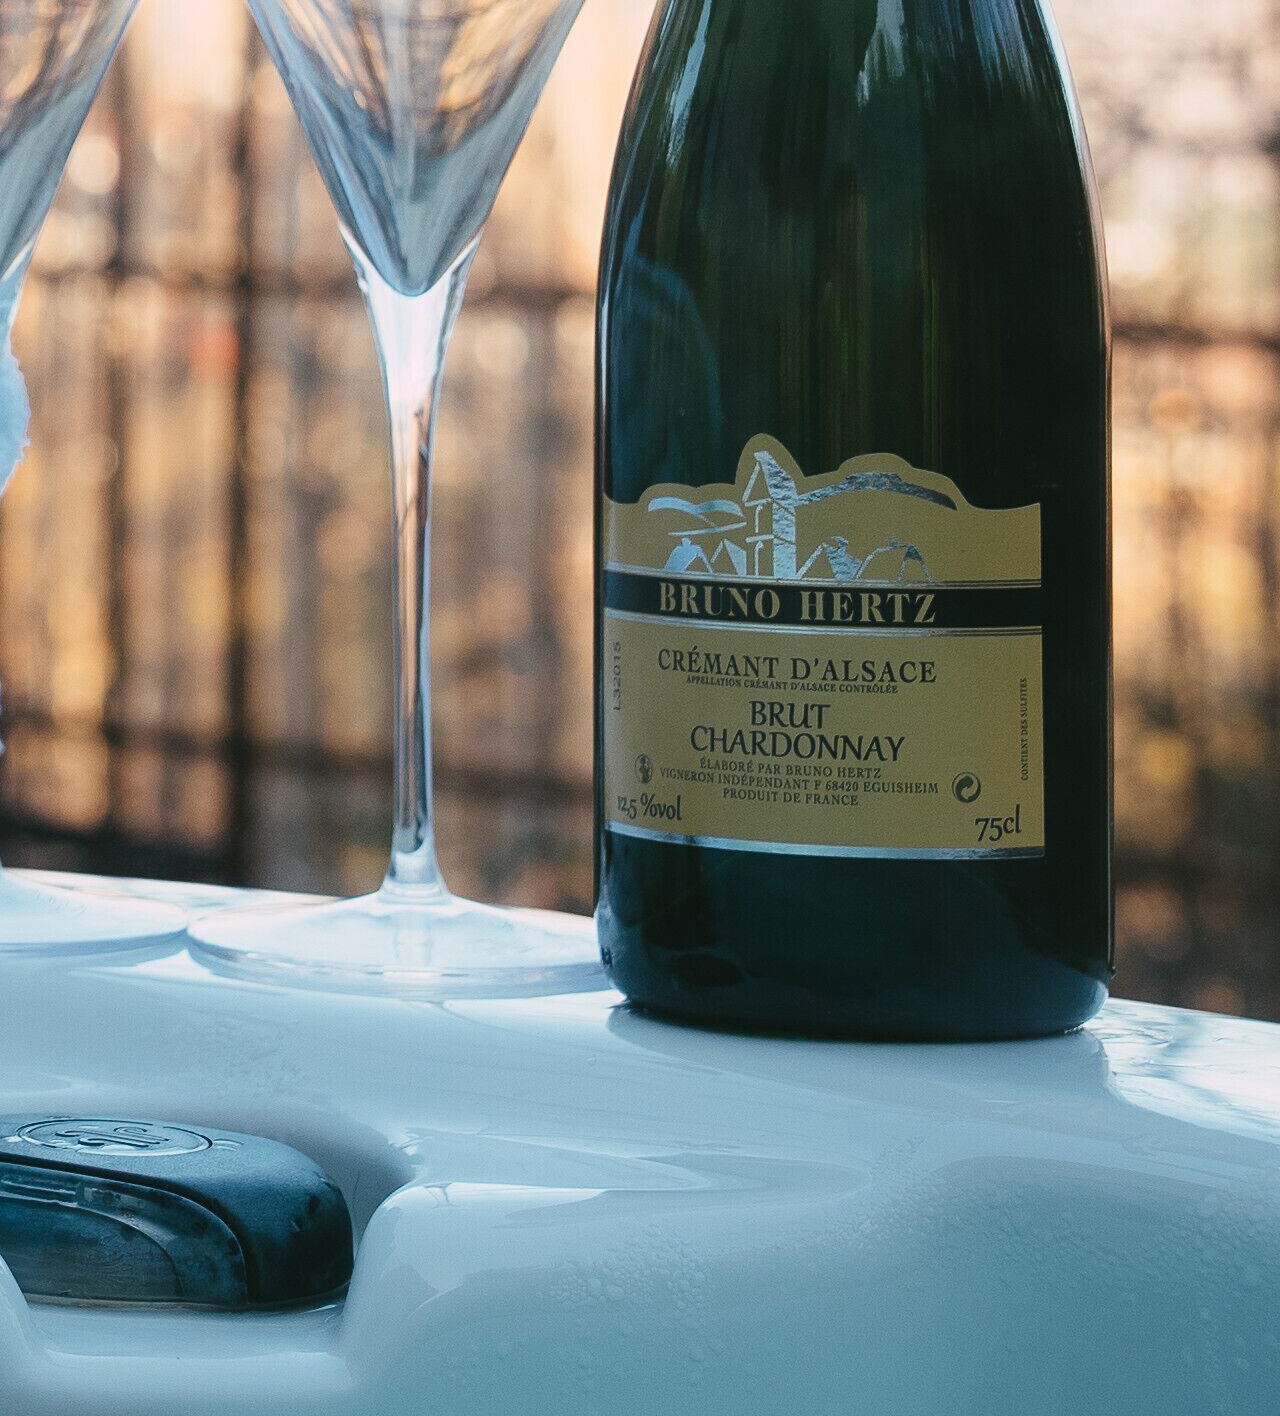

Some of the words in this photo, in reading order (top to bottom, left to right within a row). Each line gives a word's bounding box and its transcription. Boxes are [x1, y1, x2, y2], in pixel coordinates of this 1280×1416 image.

[659, 582, 780, 619] BRUNO
[800, 590, 936, 623] HERTZ
[658, 645, 779, 678] CRÉMANT
[790, 657, 937, 683] D'ALSACE
[687, 675, 741, 687] APPELLATION
[744, 679, 788, 690] CRÉMANT
[790, 682, 837, 692] D'ALSACE
[839, 683, 898, 694] CONTRÔLÉE
[1019, 677, 1028, 718] SULFITES
[749, 700, 831, 729] BRUT
[1020, 719, 1029, 735] DES
[690, 725, 905, 762] CHARDONNAY
[1020, 738, 1029, 781] CONTIENT
[660, 767, 714, 783] VIGNERON
[718, 773, 810, 790] INDÉPENDANT
[814, 781, 823, 791] F
[825, 781, 859, 792] 68420
[863, 782, 939, 794] EGUISHEIM
[700, 757, 753, 773] ÉLABORÉ
[758, 763, 781, 775] PAR
[786, 764, 833, 777] BRUNO
[837, 767, 882, 779] HERTZ
[723, 788, 778, 802] PRODUIT
[783, 792, 801, 803] DE
[805, 794, 859, 806] FRANCE
[975, 804, 1022, 842] 75cl
